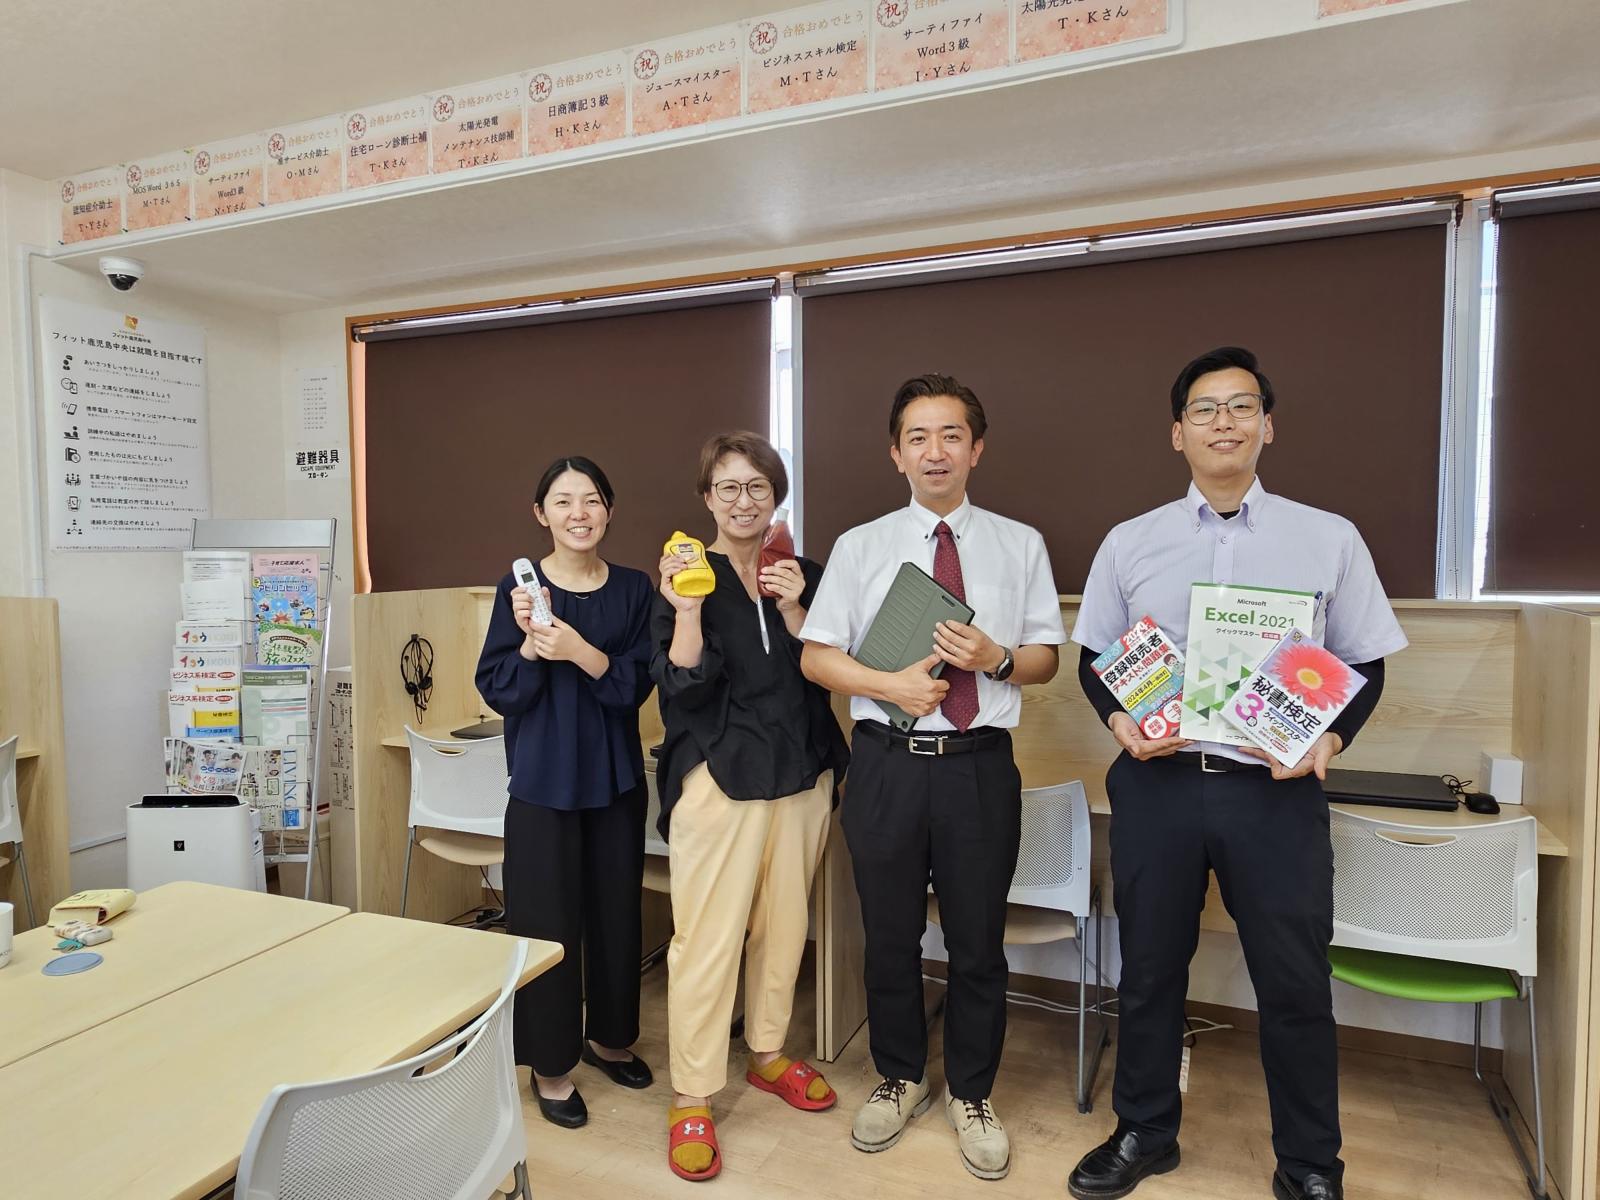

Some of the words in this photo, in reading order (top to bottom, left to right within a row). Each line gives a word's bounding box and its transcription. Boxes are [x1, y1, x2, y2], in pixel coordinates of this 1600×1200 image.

[885, 3, 901, 19] 祝
[1058, 5, 1129, 30] T・Kさん
[783, 11, 864, 39] 合格おめでとう
[904, 12, 983, 40] サーティファイ
[756, 31, 771, 45] 祝
[664, 38, 737, 64] 合格おめでとう
[763, 40, 857, 68] ビジネススキル検定
[640, 58, 653, 71] 祝
[556, 64, 622, 89] 合格おめでとう
[645, 68, 731, 94] ジュースマイスター
[780, 66, 838, 88] M・Tさん
[535, 81, 548, 94] 祝
[437, 102, 449, 115] 祝
[663, 91, 713, 111] A・Tさん
[351, 120, 362, 133] 祝
[458, 116, 499, 132] 太陽光発電
[555, 120, 601, 138] H・Kさん
[350, 131, 427, 158] 住宅ローン診断士補
[369, 157, 407, 173] T・Kさん
[458, 152, 499, 169] T・Kさん
[296, 450, 340, 466] 避難器具
[1236, 599, 1267, 607] Microsoft
[1205, 607, 1255, 625] Excel
[1259, 614, 1295, 629] 2021
[1104, 632, 1163, 686] 登録販売者
[1251, 675, 1322, 735] 秘書検定
[1263, 711, 1305, 744] クイックマスター
